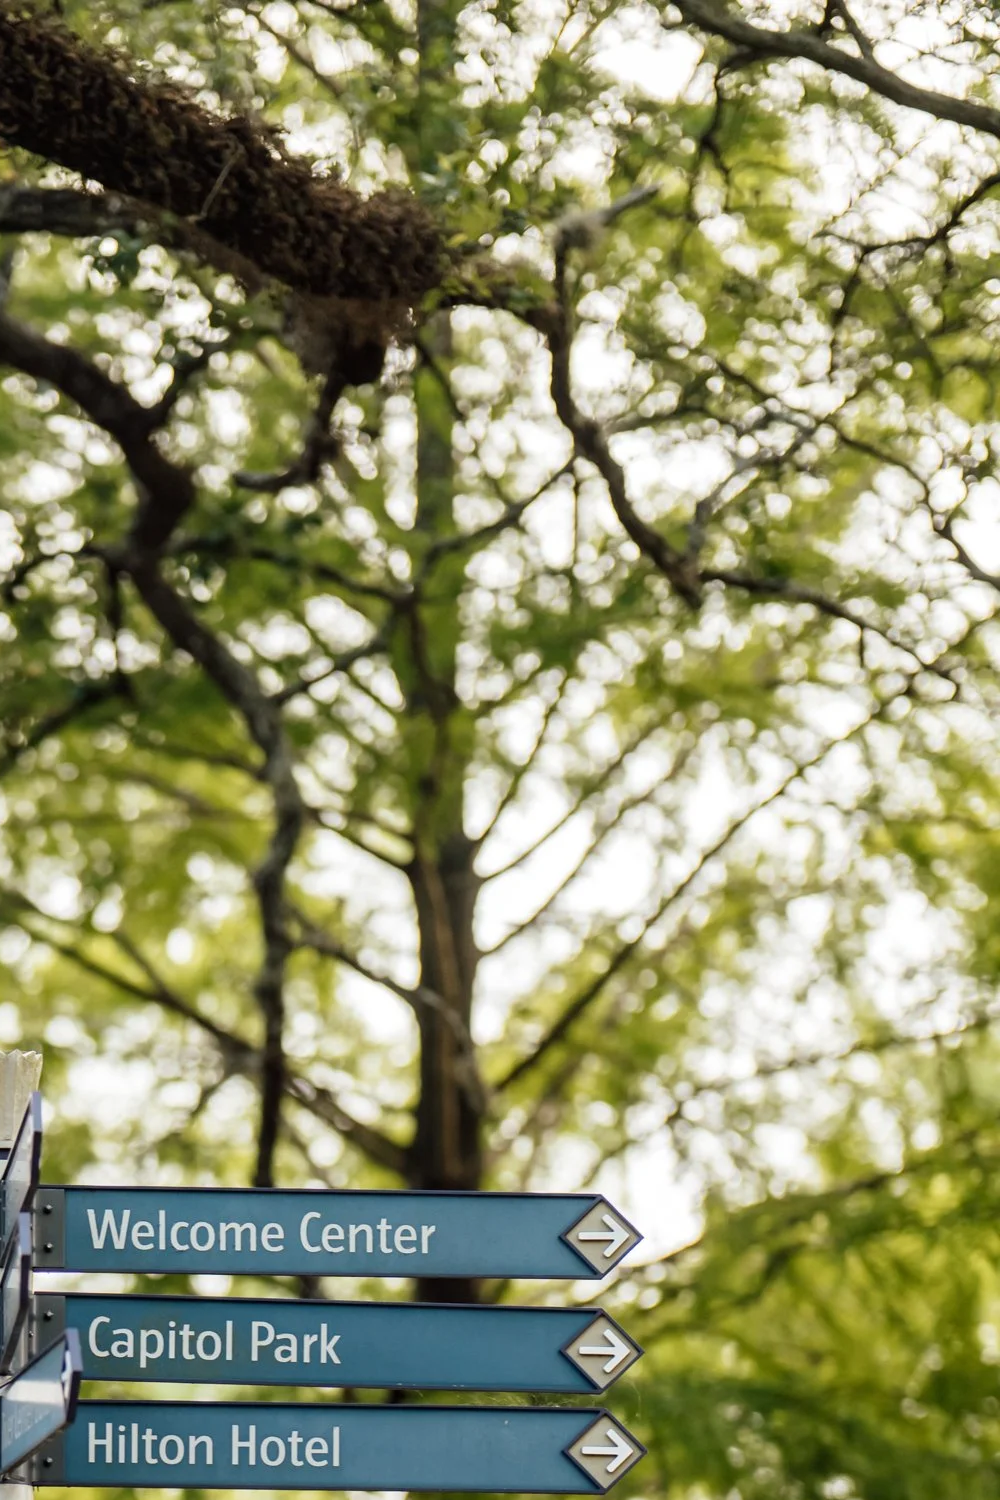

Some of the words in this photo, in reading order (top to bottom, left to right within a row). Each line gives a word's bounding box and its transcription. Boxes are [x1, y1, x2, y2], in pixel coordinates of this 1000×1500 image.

[86, 1208, 285, 1252] Welcome
[299, 1211, 436, 1254] Center
[88, 1315, 233, 1369] Capitol
[251, 1320, 341, 1364] Park
[88, 1422, 214, 1465] Hilton
[231, 1424, 340, 1467] Hotel
